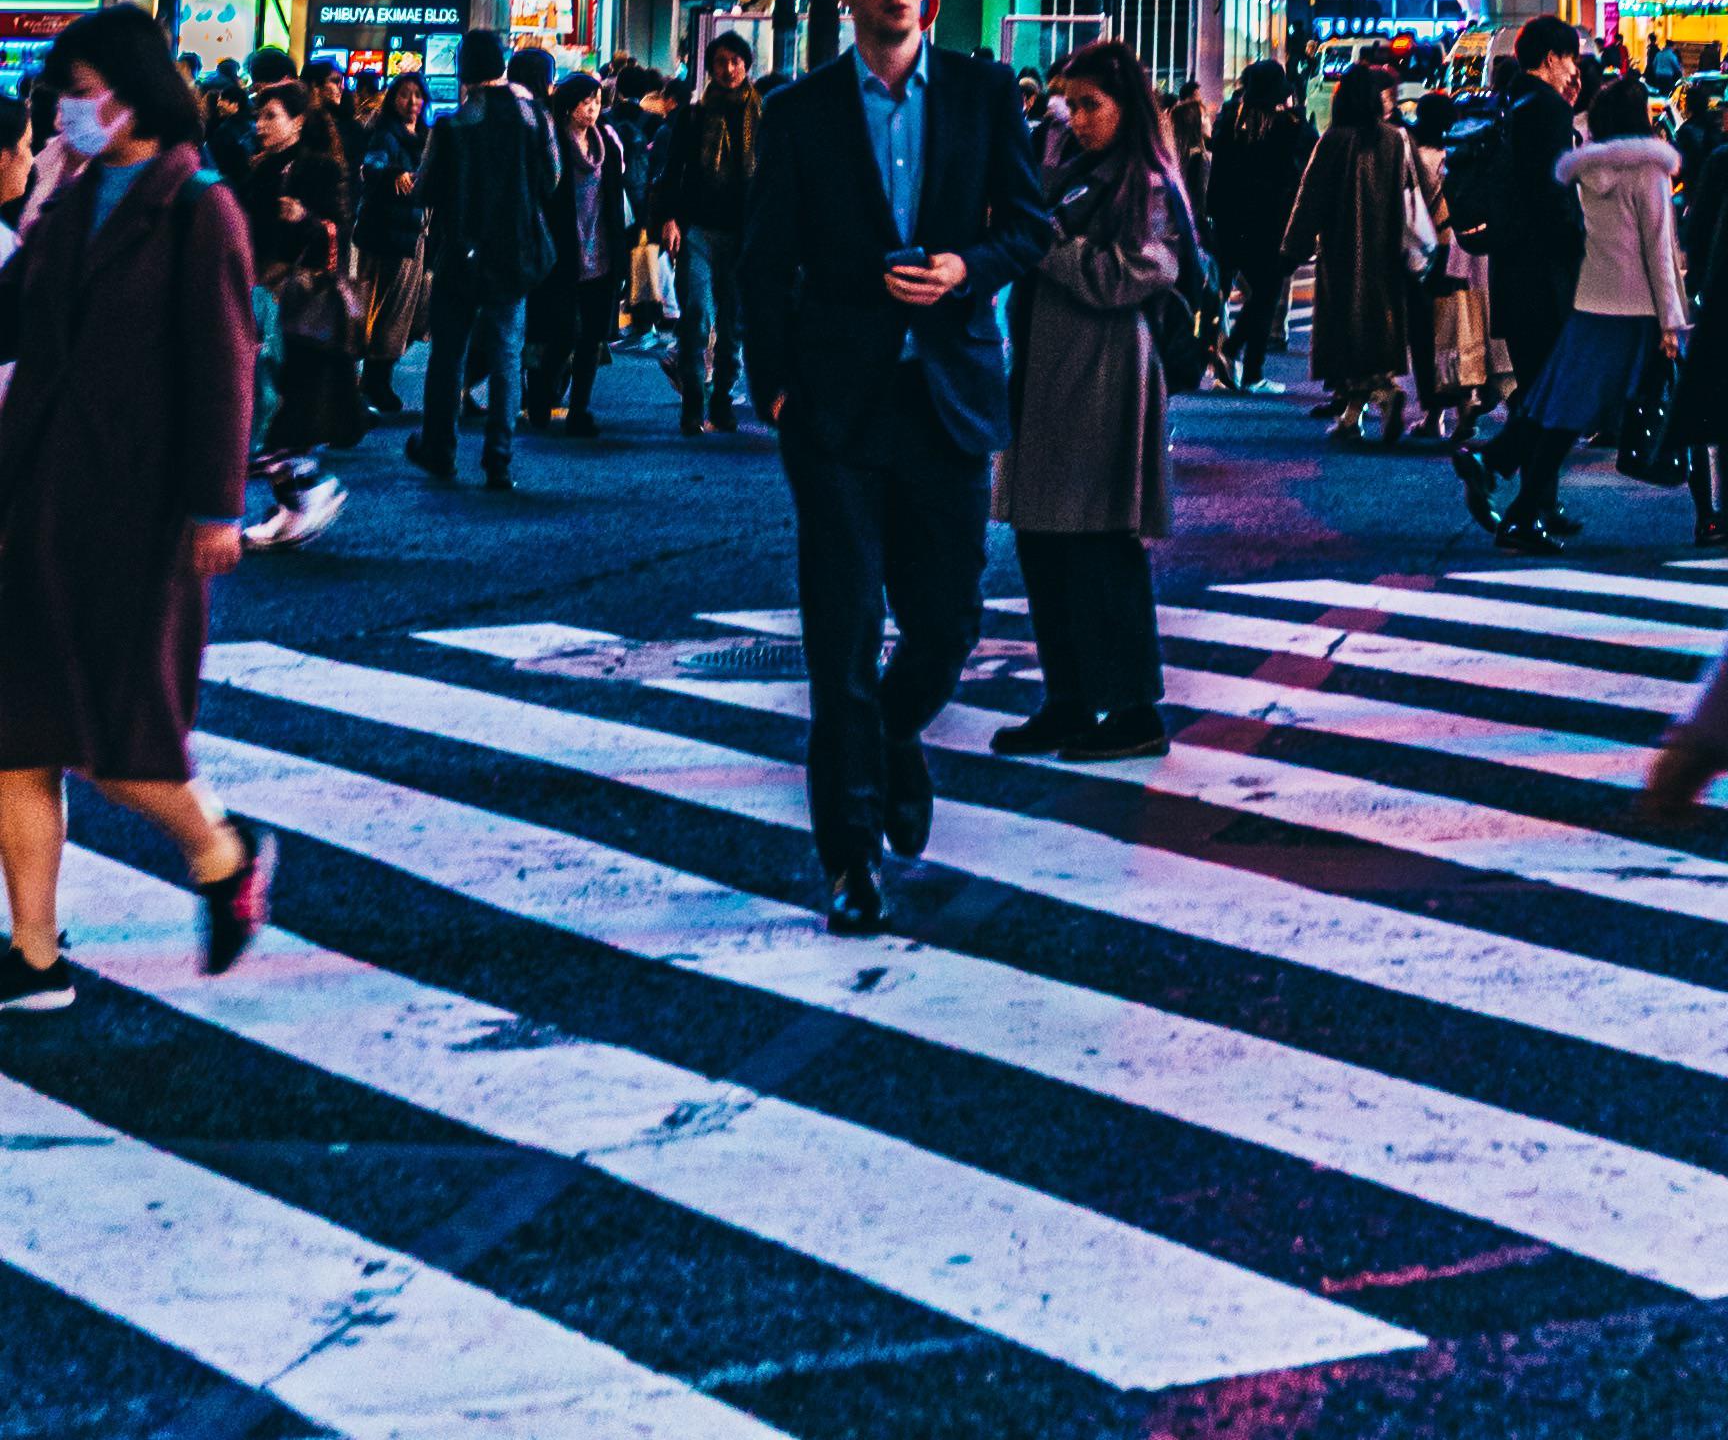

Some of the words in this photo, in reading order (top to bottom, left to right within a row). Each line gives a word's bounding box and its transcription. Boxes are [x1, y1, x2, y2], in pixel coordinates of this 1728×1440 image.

[320, 7, 375, 23] SHIBUYA
[376, 7, 423, 23] EKIMAE
[424, 7, 460, 23] BLDG.
